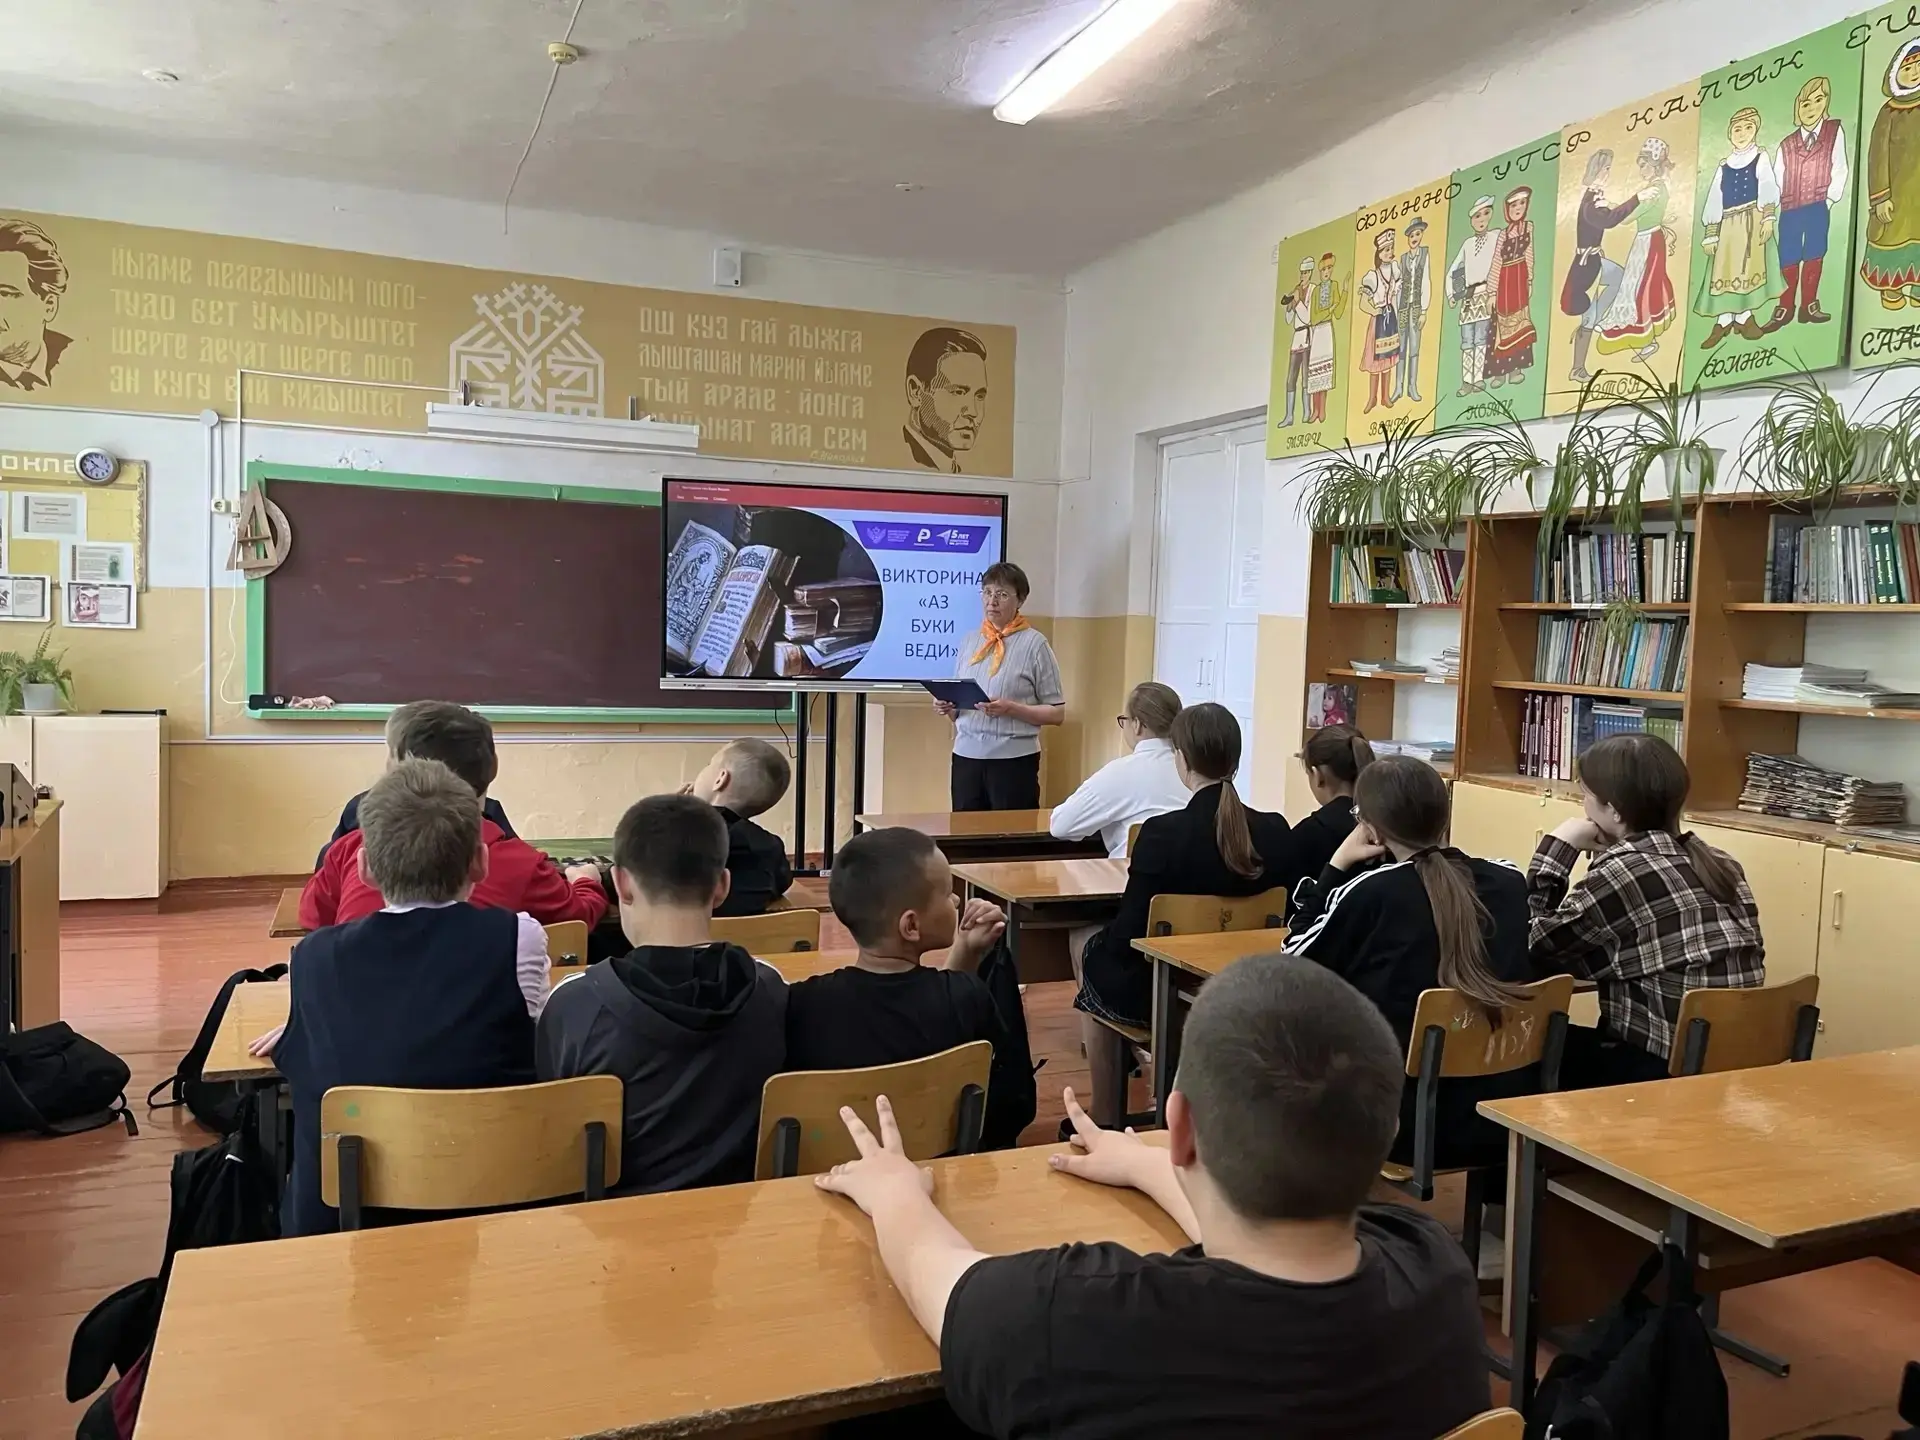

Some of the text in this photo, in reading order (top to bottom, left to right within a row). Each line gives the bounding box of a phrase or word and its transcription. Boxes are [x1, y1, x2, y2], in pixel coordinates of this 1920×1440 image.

[1626, 50, 1804, 132] КАЛЫК
[109, 287, 175, 321] ТУДО
[191, 298, 240, 328] ВЕТ
[640, 306, 674, 335] ОШ
[740, 317, 777, 344] ГАЙ
[112, 326, 188, 360] ШЕРГЕ
[280, 344, 352, 377] ШЕРГЕ
[1703, 347, 1777, 378] ФИНН
[749, 352, 806, 381] МАРИЙ
[110, 365, 140, 395] ЭН
[154, 368, 212, 400] КУГУ
[638, 377, 691, 404] ТЫЙ
[824, 426, 867, 452] СЕМ
[882, 568, 984, 585] ВИКТОРИНА
[919, 595, 949, 609] «АЗ
[911, 618, 955, 634] БУКИ
[905, 643, 959, 661] ВЕДИ»
